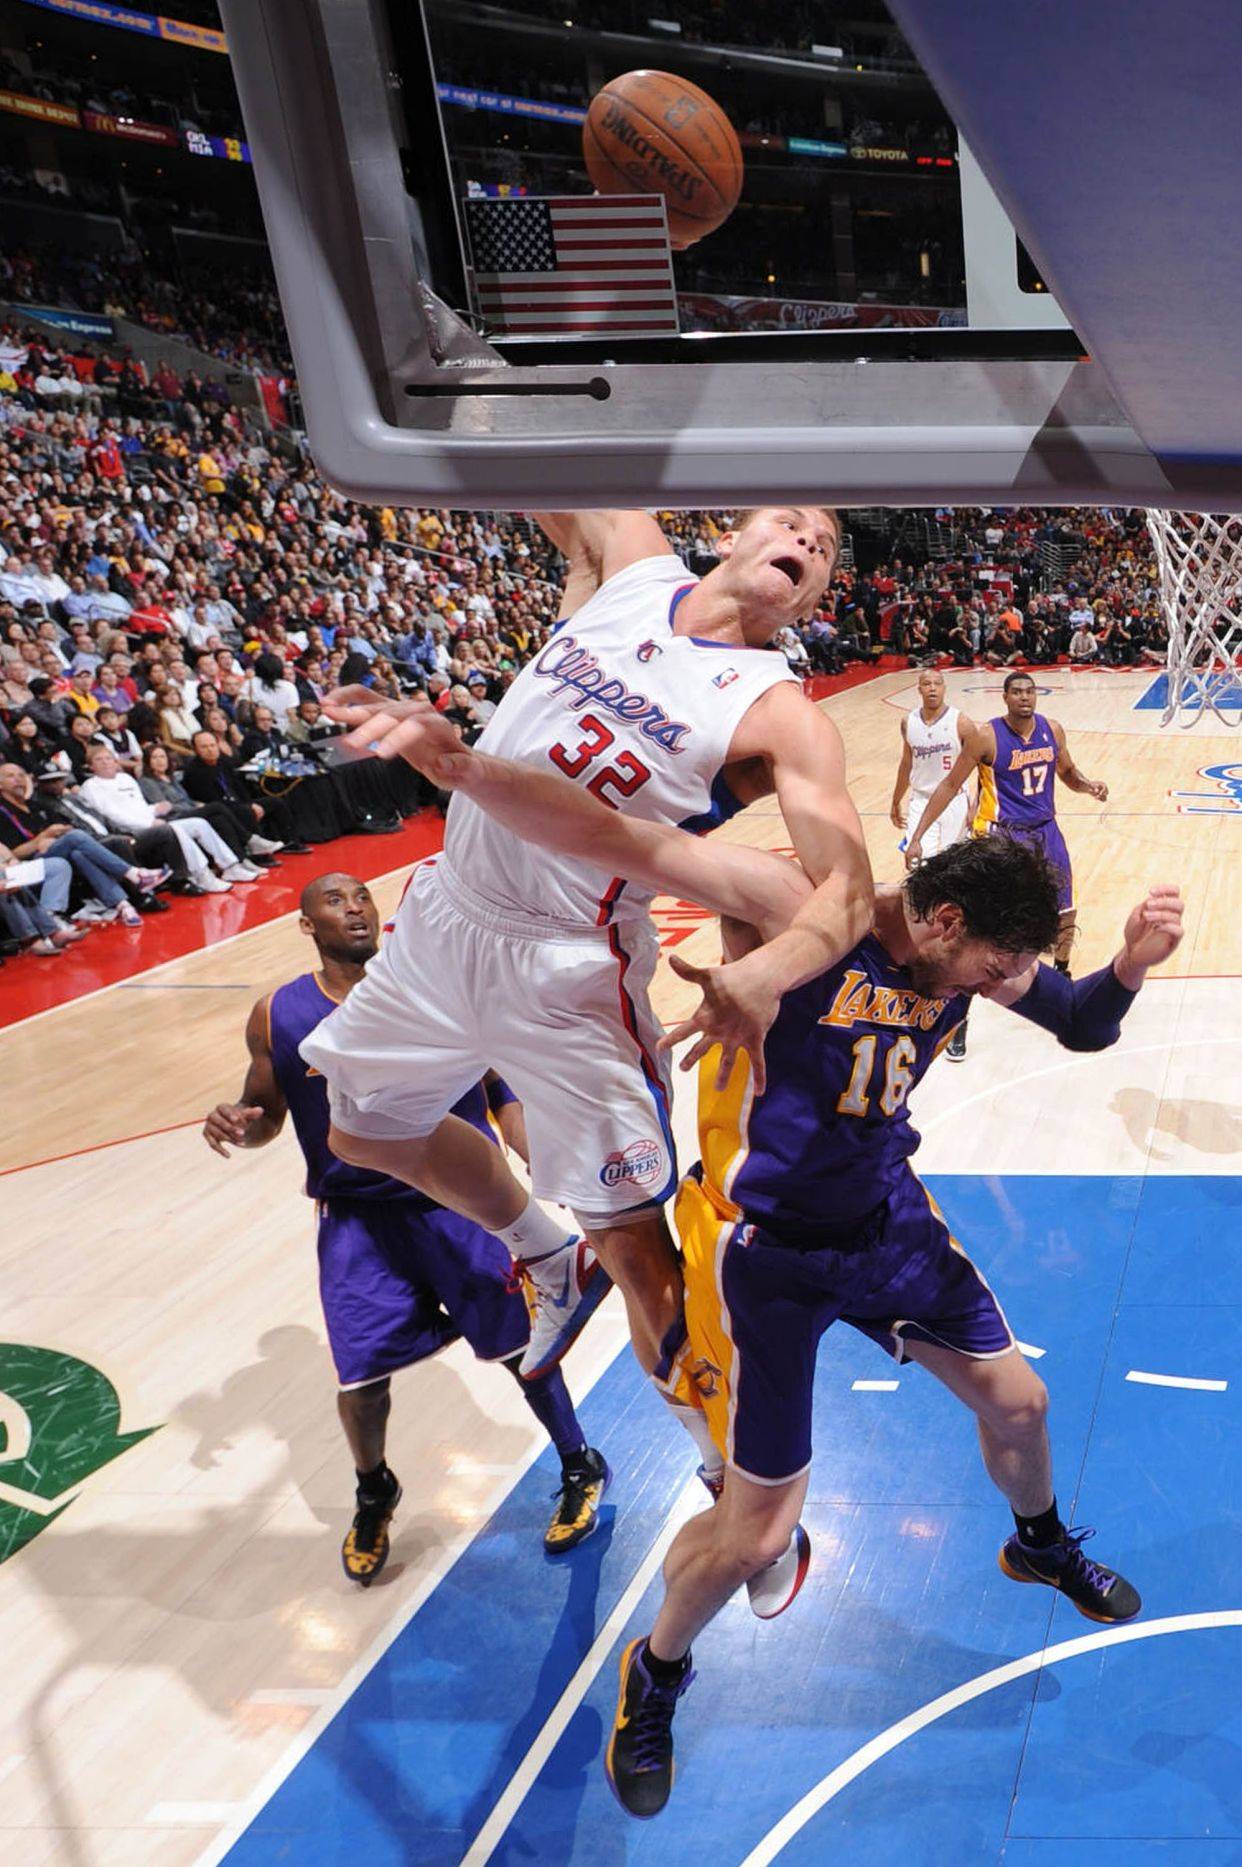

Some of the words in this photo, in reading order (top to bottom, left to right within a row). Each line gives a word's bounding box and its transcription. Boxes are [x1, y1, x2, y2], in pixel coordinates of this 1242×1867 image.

[601, 102, 703, 201] SPALDING
[868, 148, 908, 161] TOYOTA
[780, 304, 857, 328] Clippers
[533, 636, 692, 755] Clippers
[549, 713, 652, 810] 32
[911, 743, 952, 760] Clippers
[942, 755, 952, 771] 5
[1008, 746, 1054, 771] LAKERS
[1021, 764, 1049, 796] 17
[817, 969, 950, 1031] LAKERS
[836, 1034, 917, 1117] 16
[600, 1157, 660, 1187] CLIPPERS
